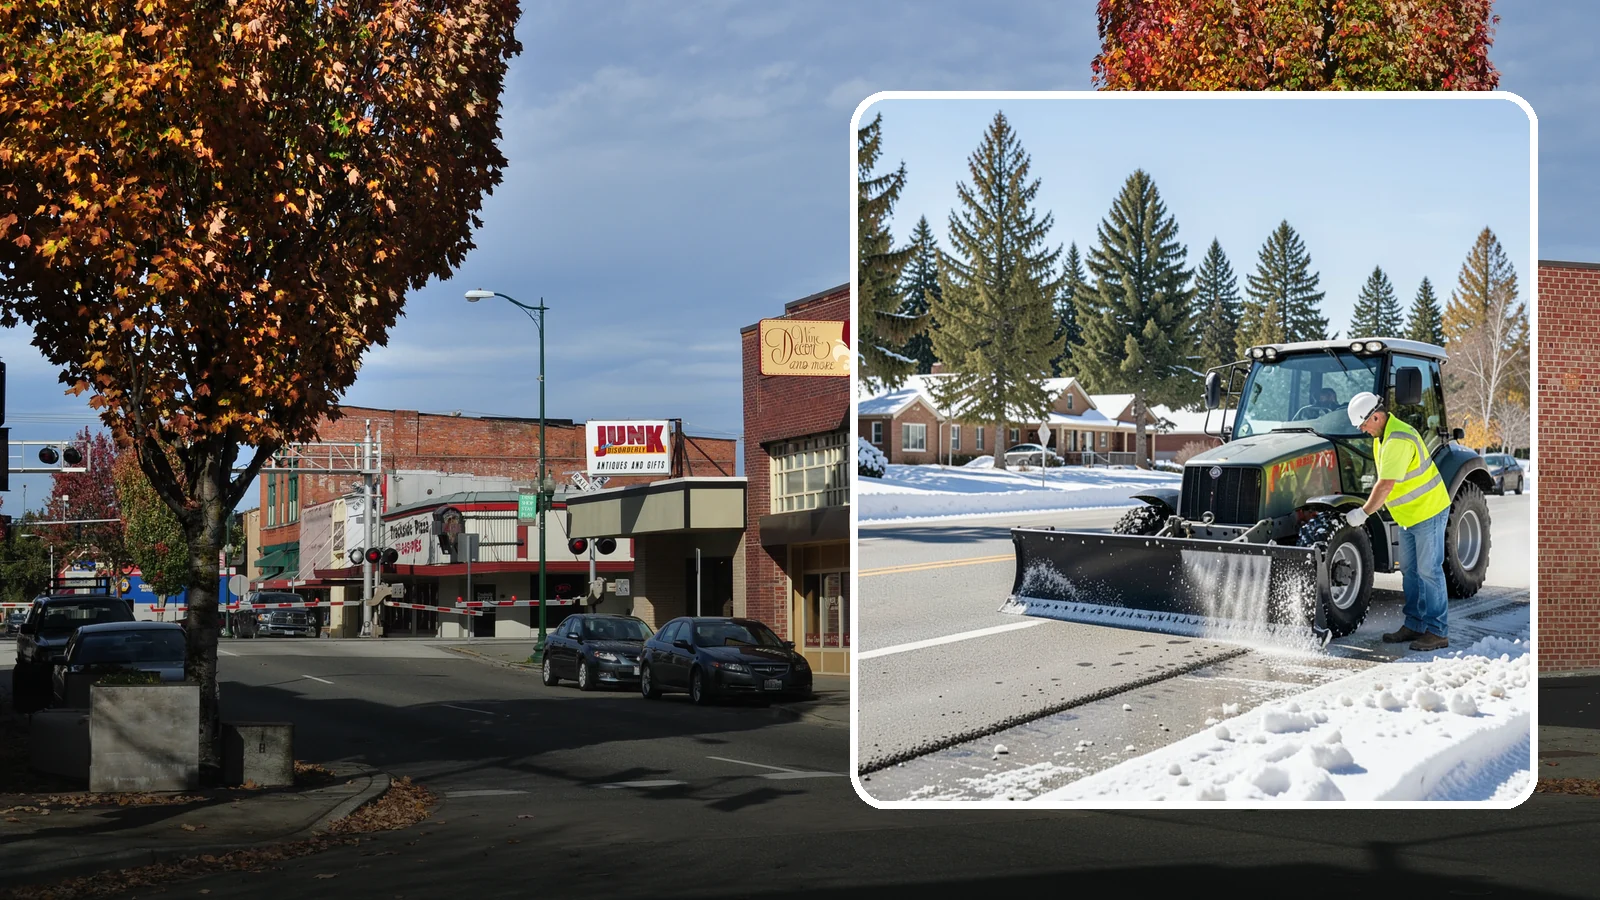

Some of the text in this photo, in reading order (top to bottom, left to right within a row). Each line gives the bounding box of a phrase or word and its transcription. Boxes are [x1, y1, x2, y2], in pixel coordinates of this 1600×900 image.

[595, 425, 665, 457] JUNK
[607, 446, 646, 454] DISORDERLY
[597, 460, 666, 470] ANTIQUES AND GIFTS
[414, 519, 429, 535] Pizza
